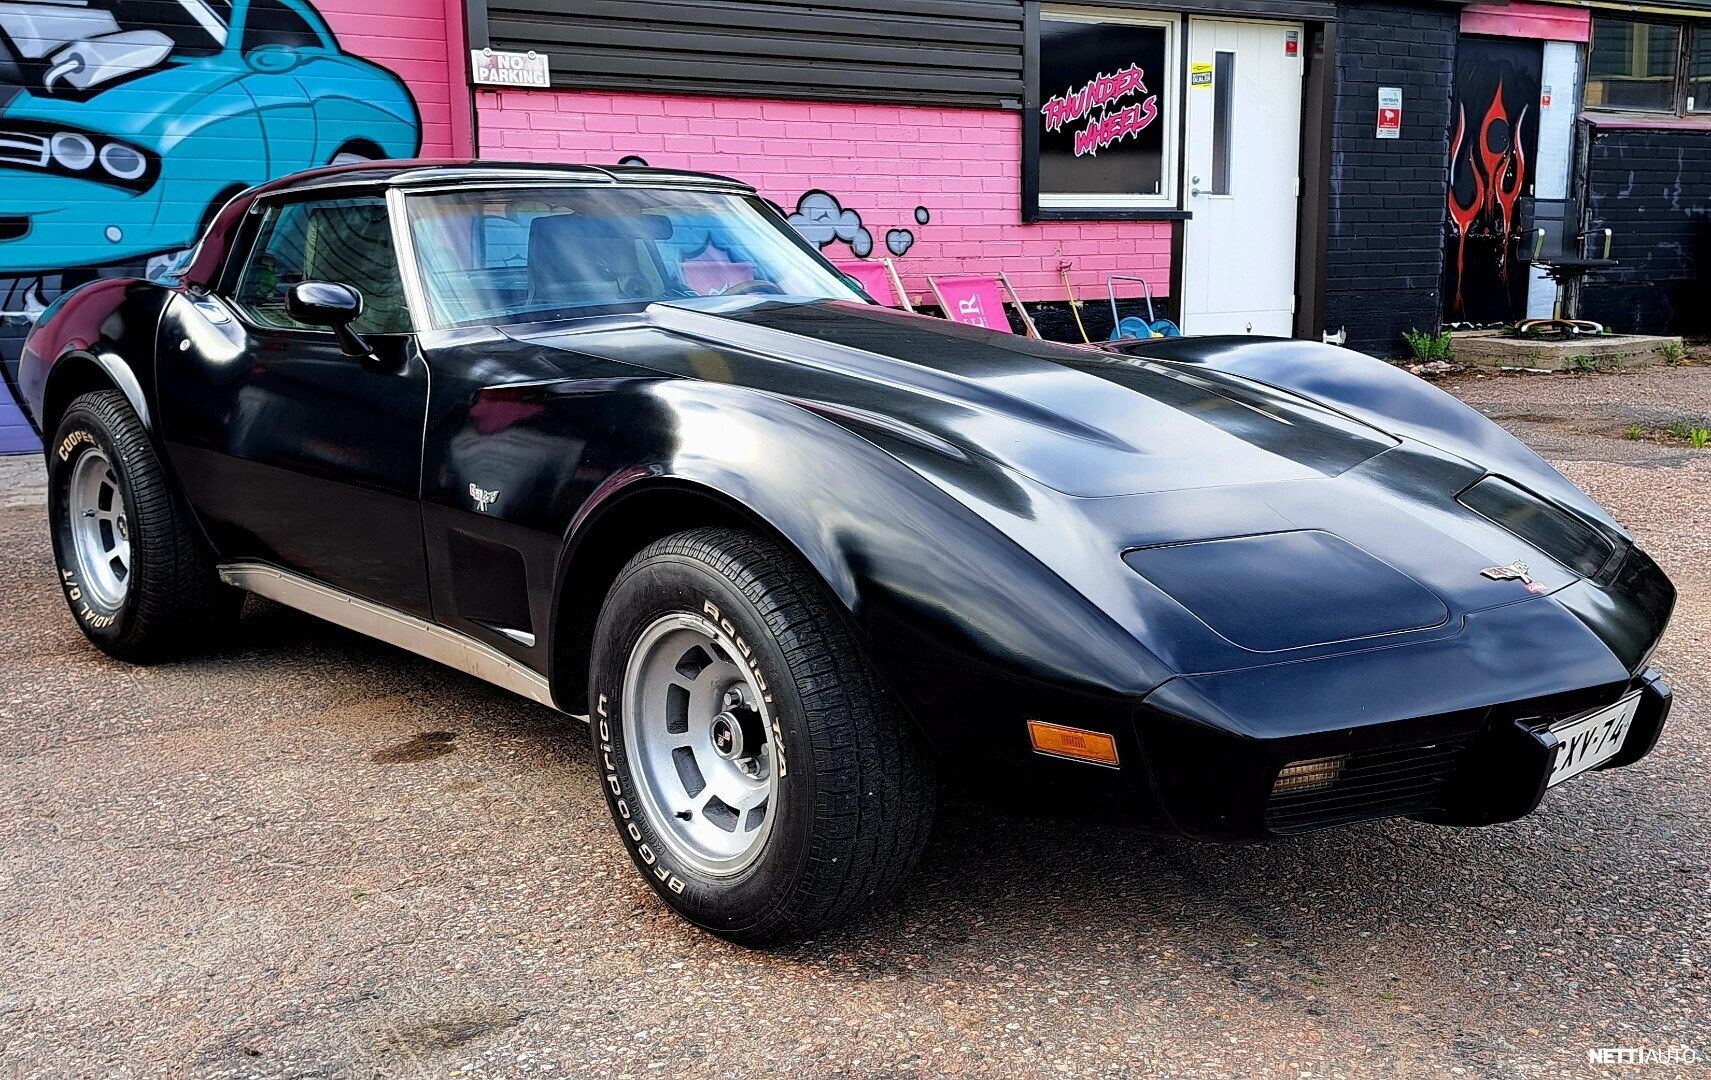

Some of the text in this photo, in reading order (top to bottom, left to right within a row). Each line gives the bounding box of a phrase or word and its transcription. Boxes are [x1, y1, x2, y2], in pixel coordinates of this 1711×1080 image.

[479, 67, 545, 84] PARKING
[497, 55, 524, 69] NO
[1041, 62, 1148, 133] THUNDER
[1074, 95, 1158, 157] WHEELS
[703, 600, 787, 778] Radial T/A
[596, 692, 687, 895] BFGoodrich
